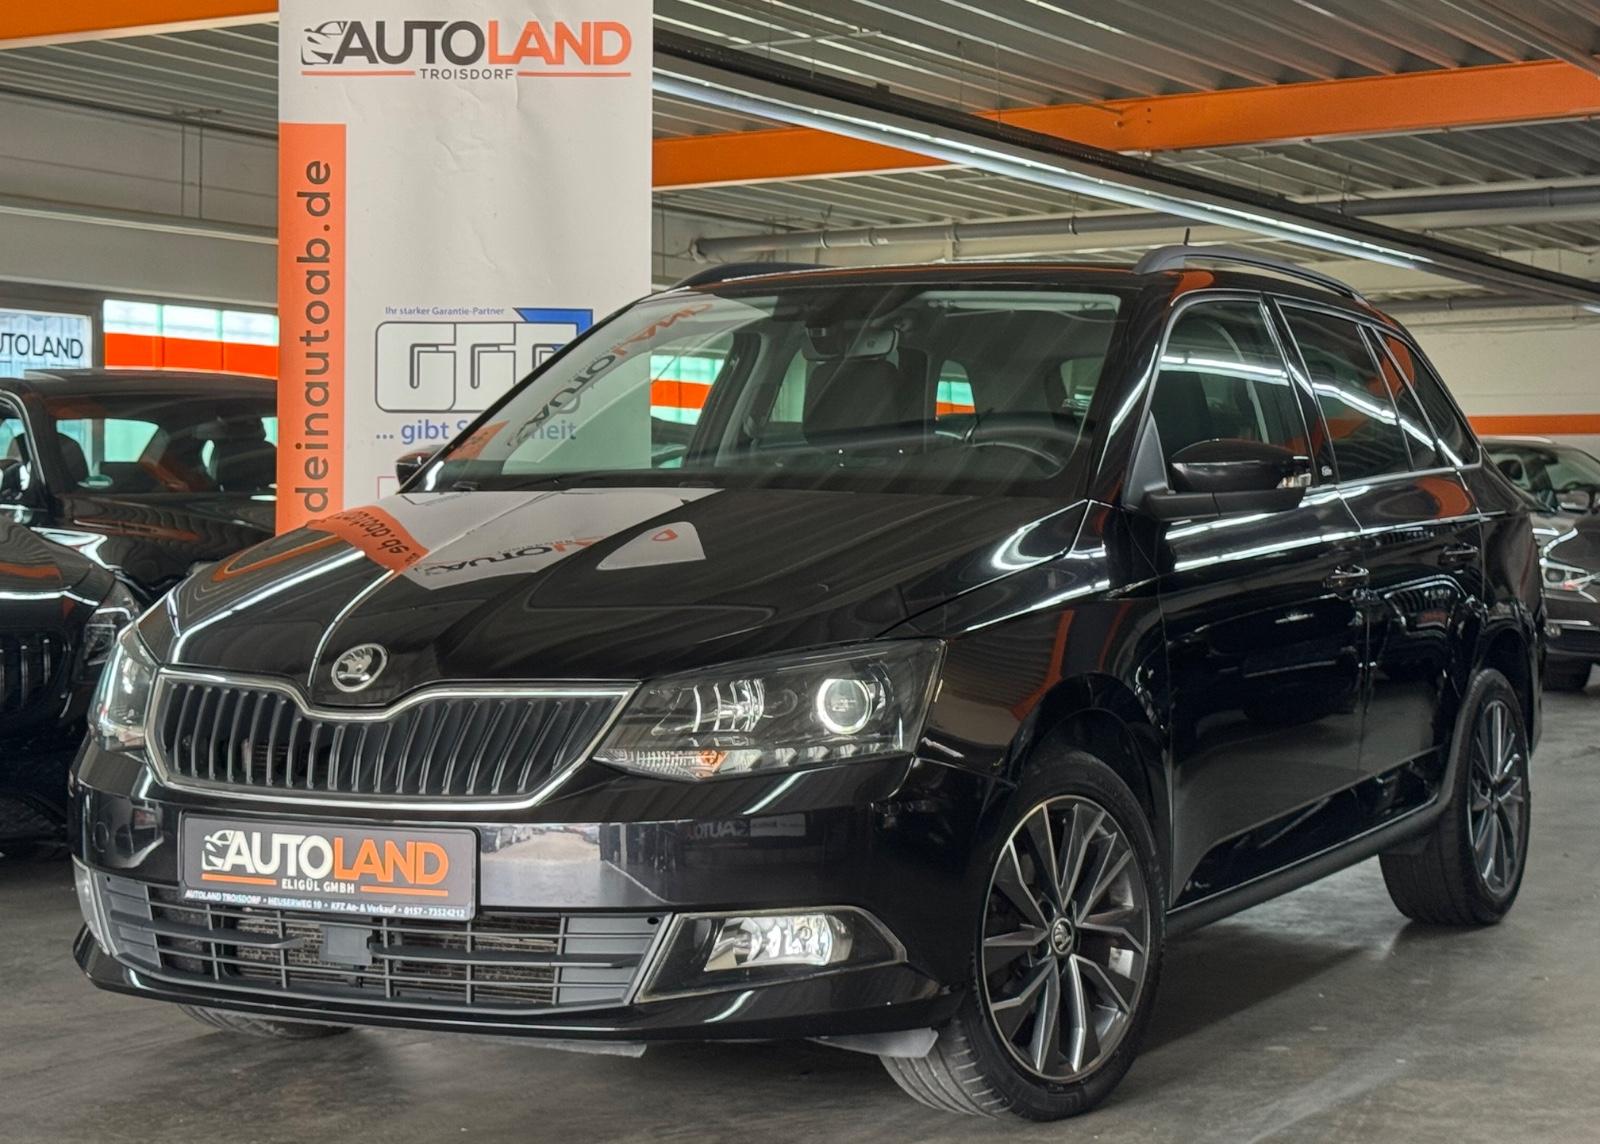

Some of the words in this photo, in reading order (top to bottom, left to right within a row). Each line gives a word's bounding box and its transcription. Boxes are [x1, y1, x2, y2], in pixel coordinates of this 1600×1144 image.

[333, 20, 632, 66] AUTOLAND
[419, 67, 514, 81] TROISDORF
[385, 306, 397, 315] Ihr
[400, 306, 430, 315] starker
[431, 306, 505, 316] Garantie-Partner
[295, 160, 331, 513] deinautoab.de
[401, 419, 449, 445] gibt
[223, 830, 449, 885] AUTOLAND
[281, 878, 321, 892] ELIGÜL
[323, 881, 355, 894] GMBH
[185, 889, 222, 901] AUTOLAND
[222, 892, 262, 905] TROISDORF
[331, 902, 346, 910] KFZ
[367, 904, 397, 913] Verkauf
